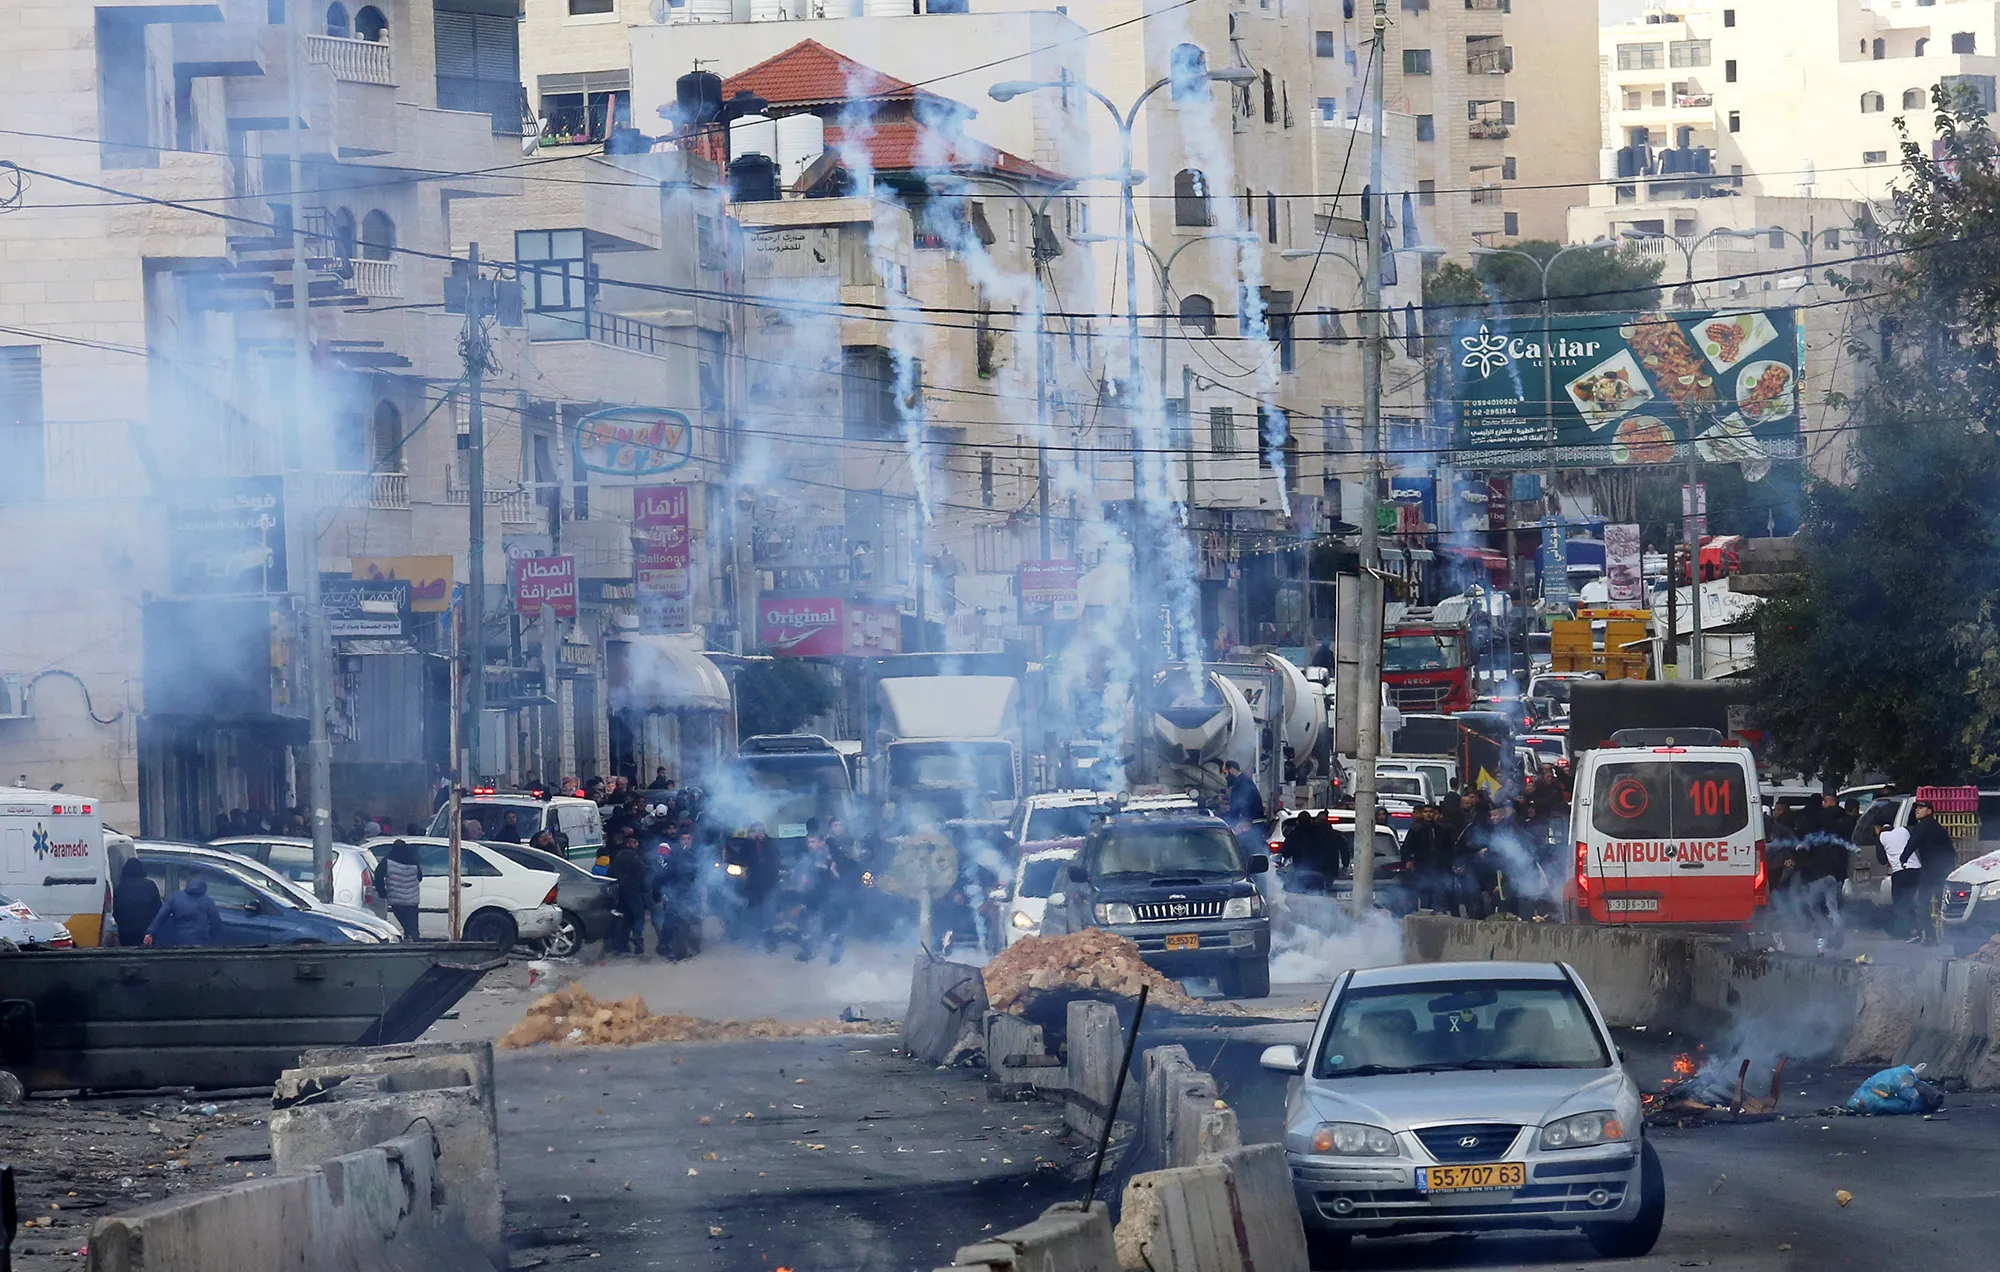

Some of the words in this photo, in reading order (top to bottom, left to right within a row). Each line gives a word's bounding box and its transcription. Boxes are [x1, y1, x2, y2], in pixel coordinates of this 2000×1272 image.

[637, 490, 685, 519] أزهار
[521, 560, 571, 581] المطار
[521, 582, 573, 600] للصرافة
[766, 607, 837, 628] Original
[1689, 779, 1731, 816] 101
[49, 839, 89, 858] Paramedic
[1602, 841, 1729, 863] AMBULANCE
[1732, 845, 1751, 856] 1-7
